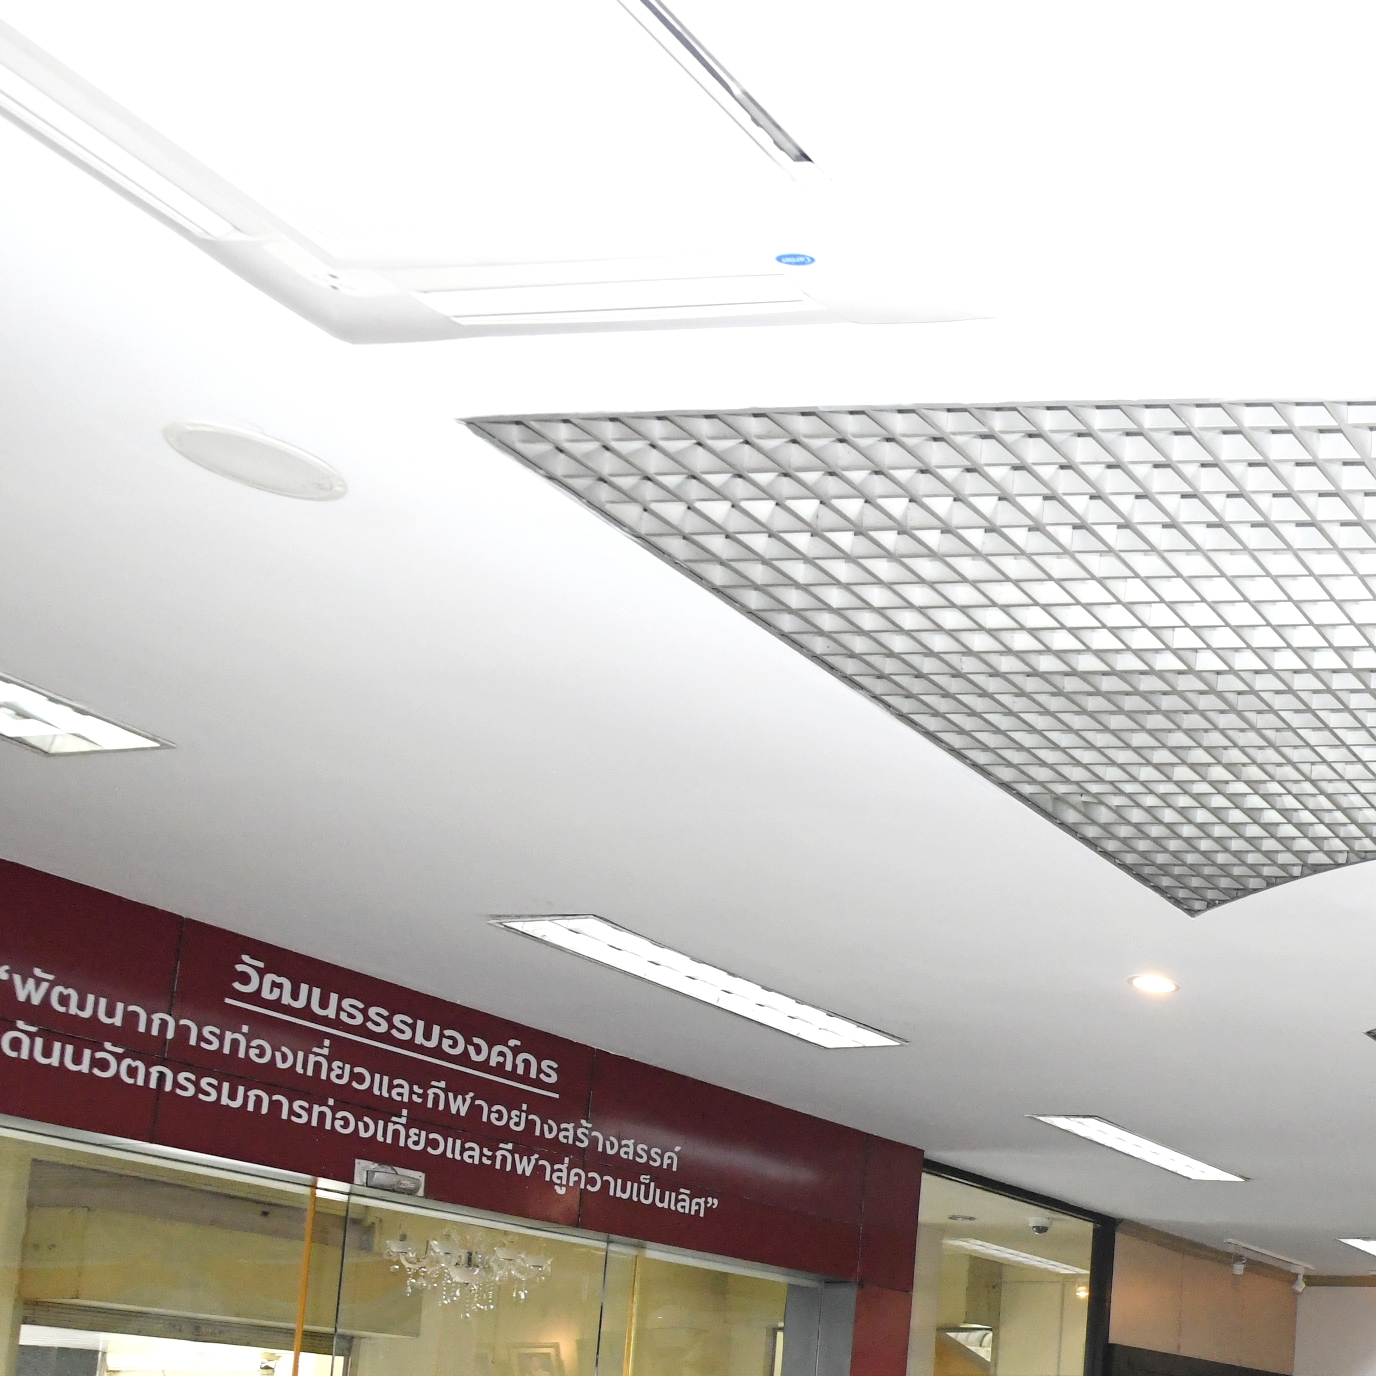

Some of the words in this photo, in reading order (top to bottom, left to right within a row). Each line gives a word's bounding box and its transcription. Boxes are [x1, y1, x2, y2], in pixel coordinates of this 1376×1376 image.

[232, 954, 558, 1083] วัฒนธรรมองค์กร
[0, 1020, 718, 1217] ดันนวัตกรรมการท่องเที่ยวและกีฬาสู่ความเป็นเลิศ”
